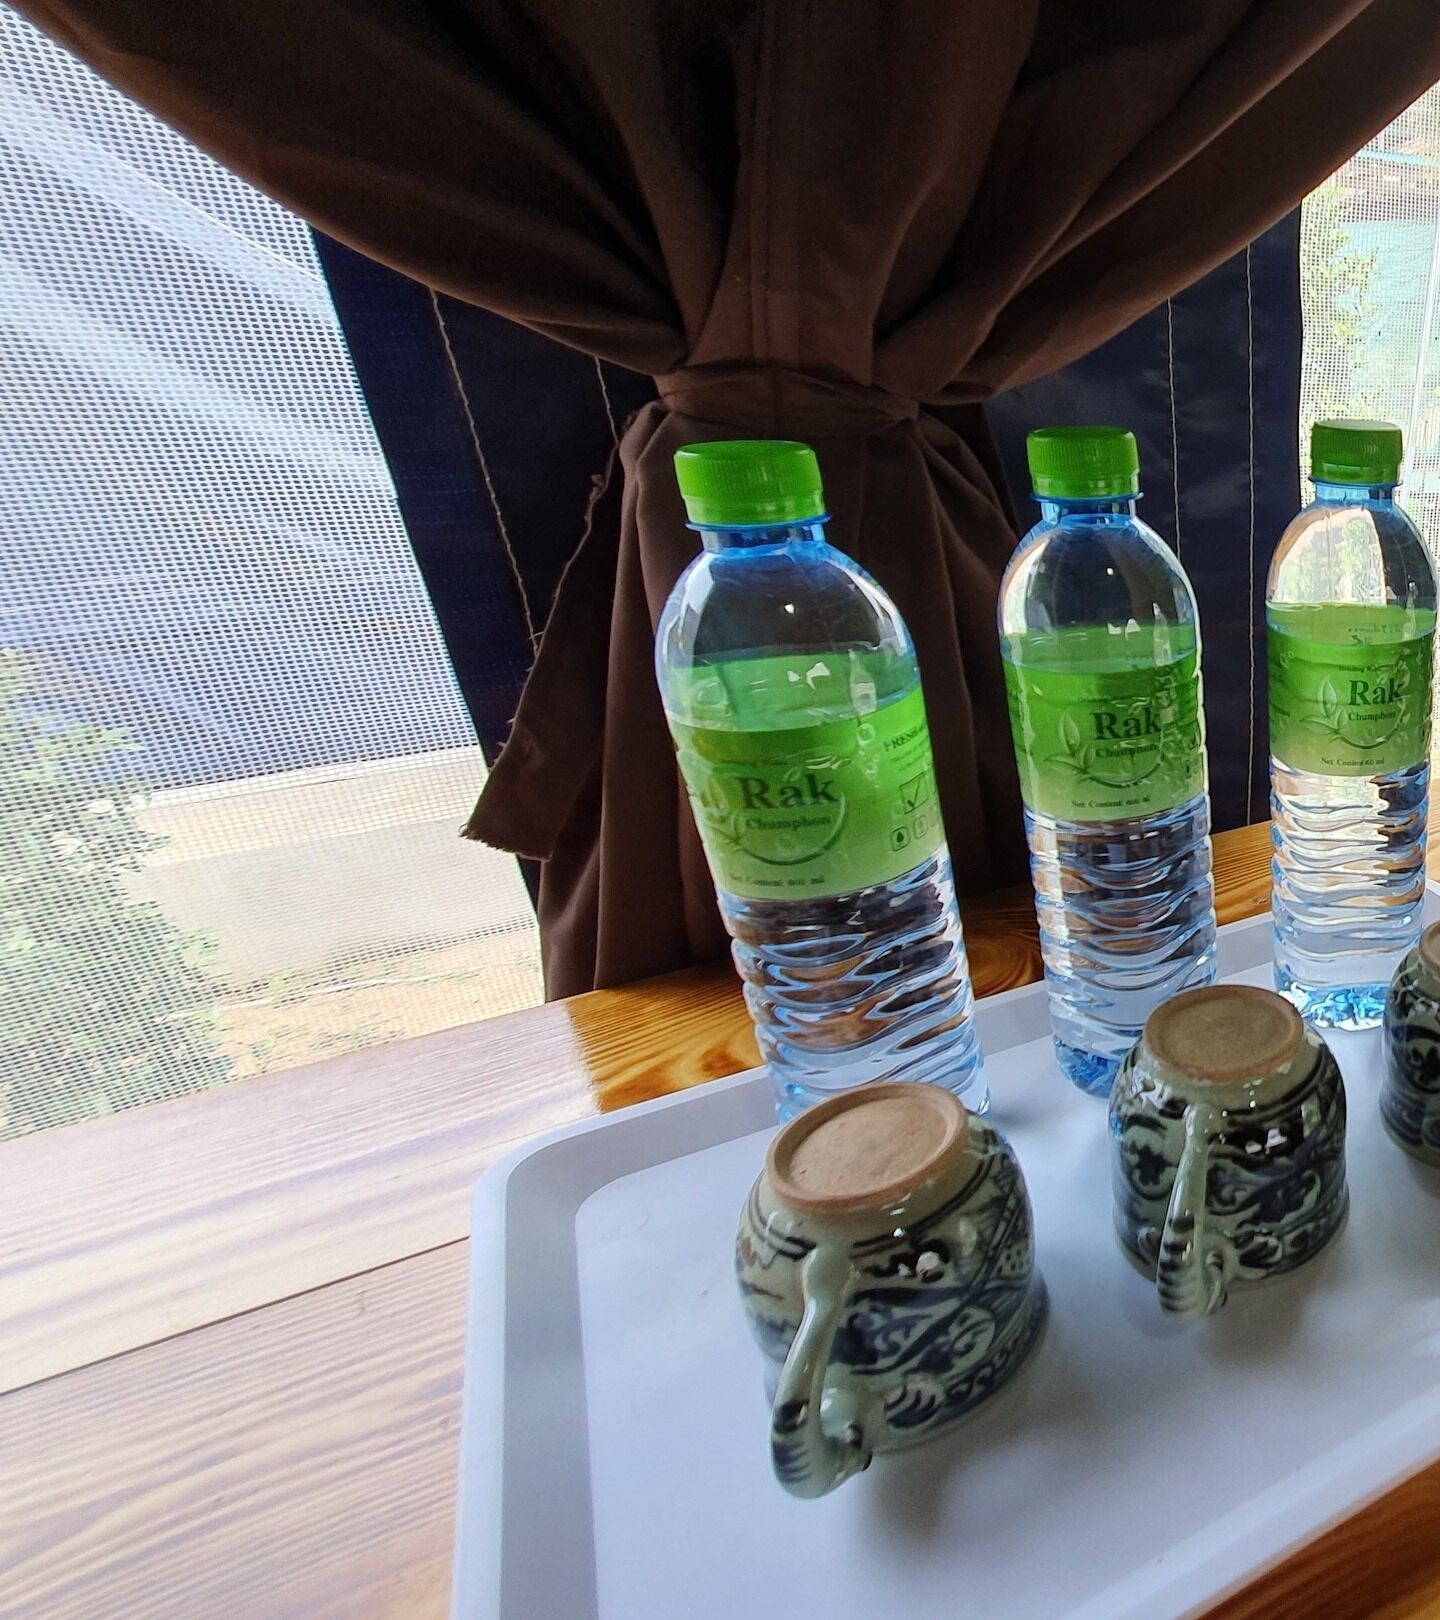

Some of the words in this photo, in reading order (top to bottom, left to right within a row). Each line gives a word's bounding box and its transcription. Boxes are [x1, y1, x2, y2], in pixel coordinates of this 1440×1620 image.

[1348, 678, 1404, 707] Rak
[1091, 706, 1162, 740] Rak
[1348, 711, 1397, 723] Chumphon
[734, 773, 839, 809] Rak
[746, 815, 831, 831] Chumphon
